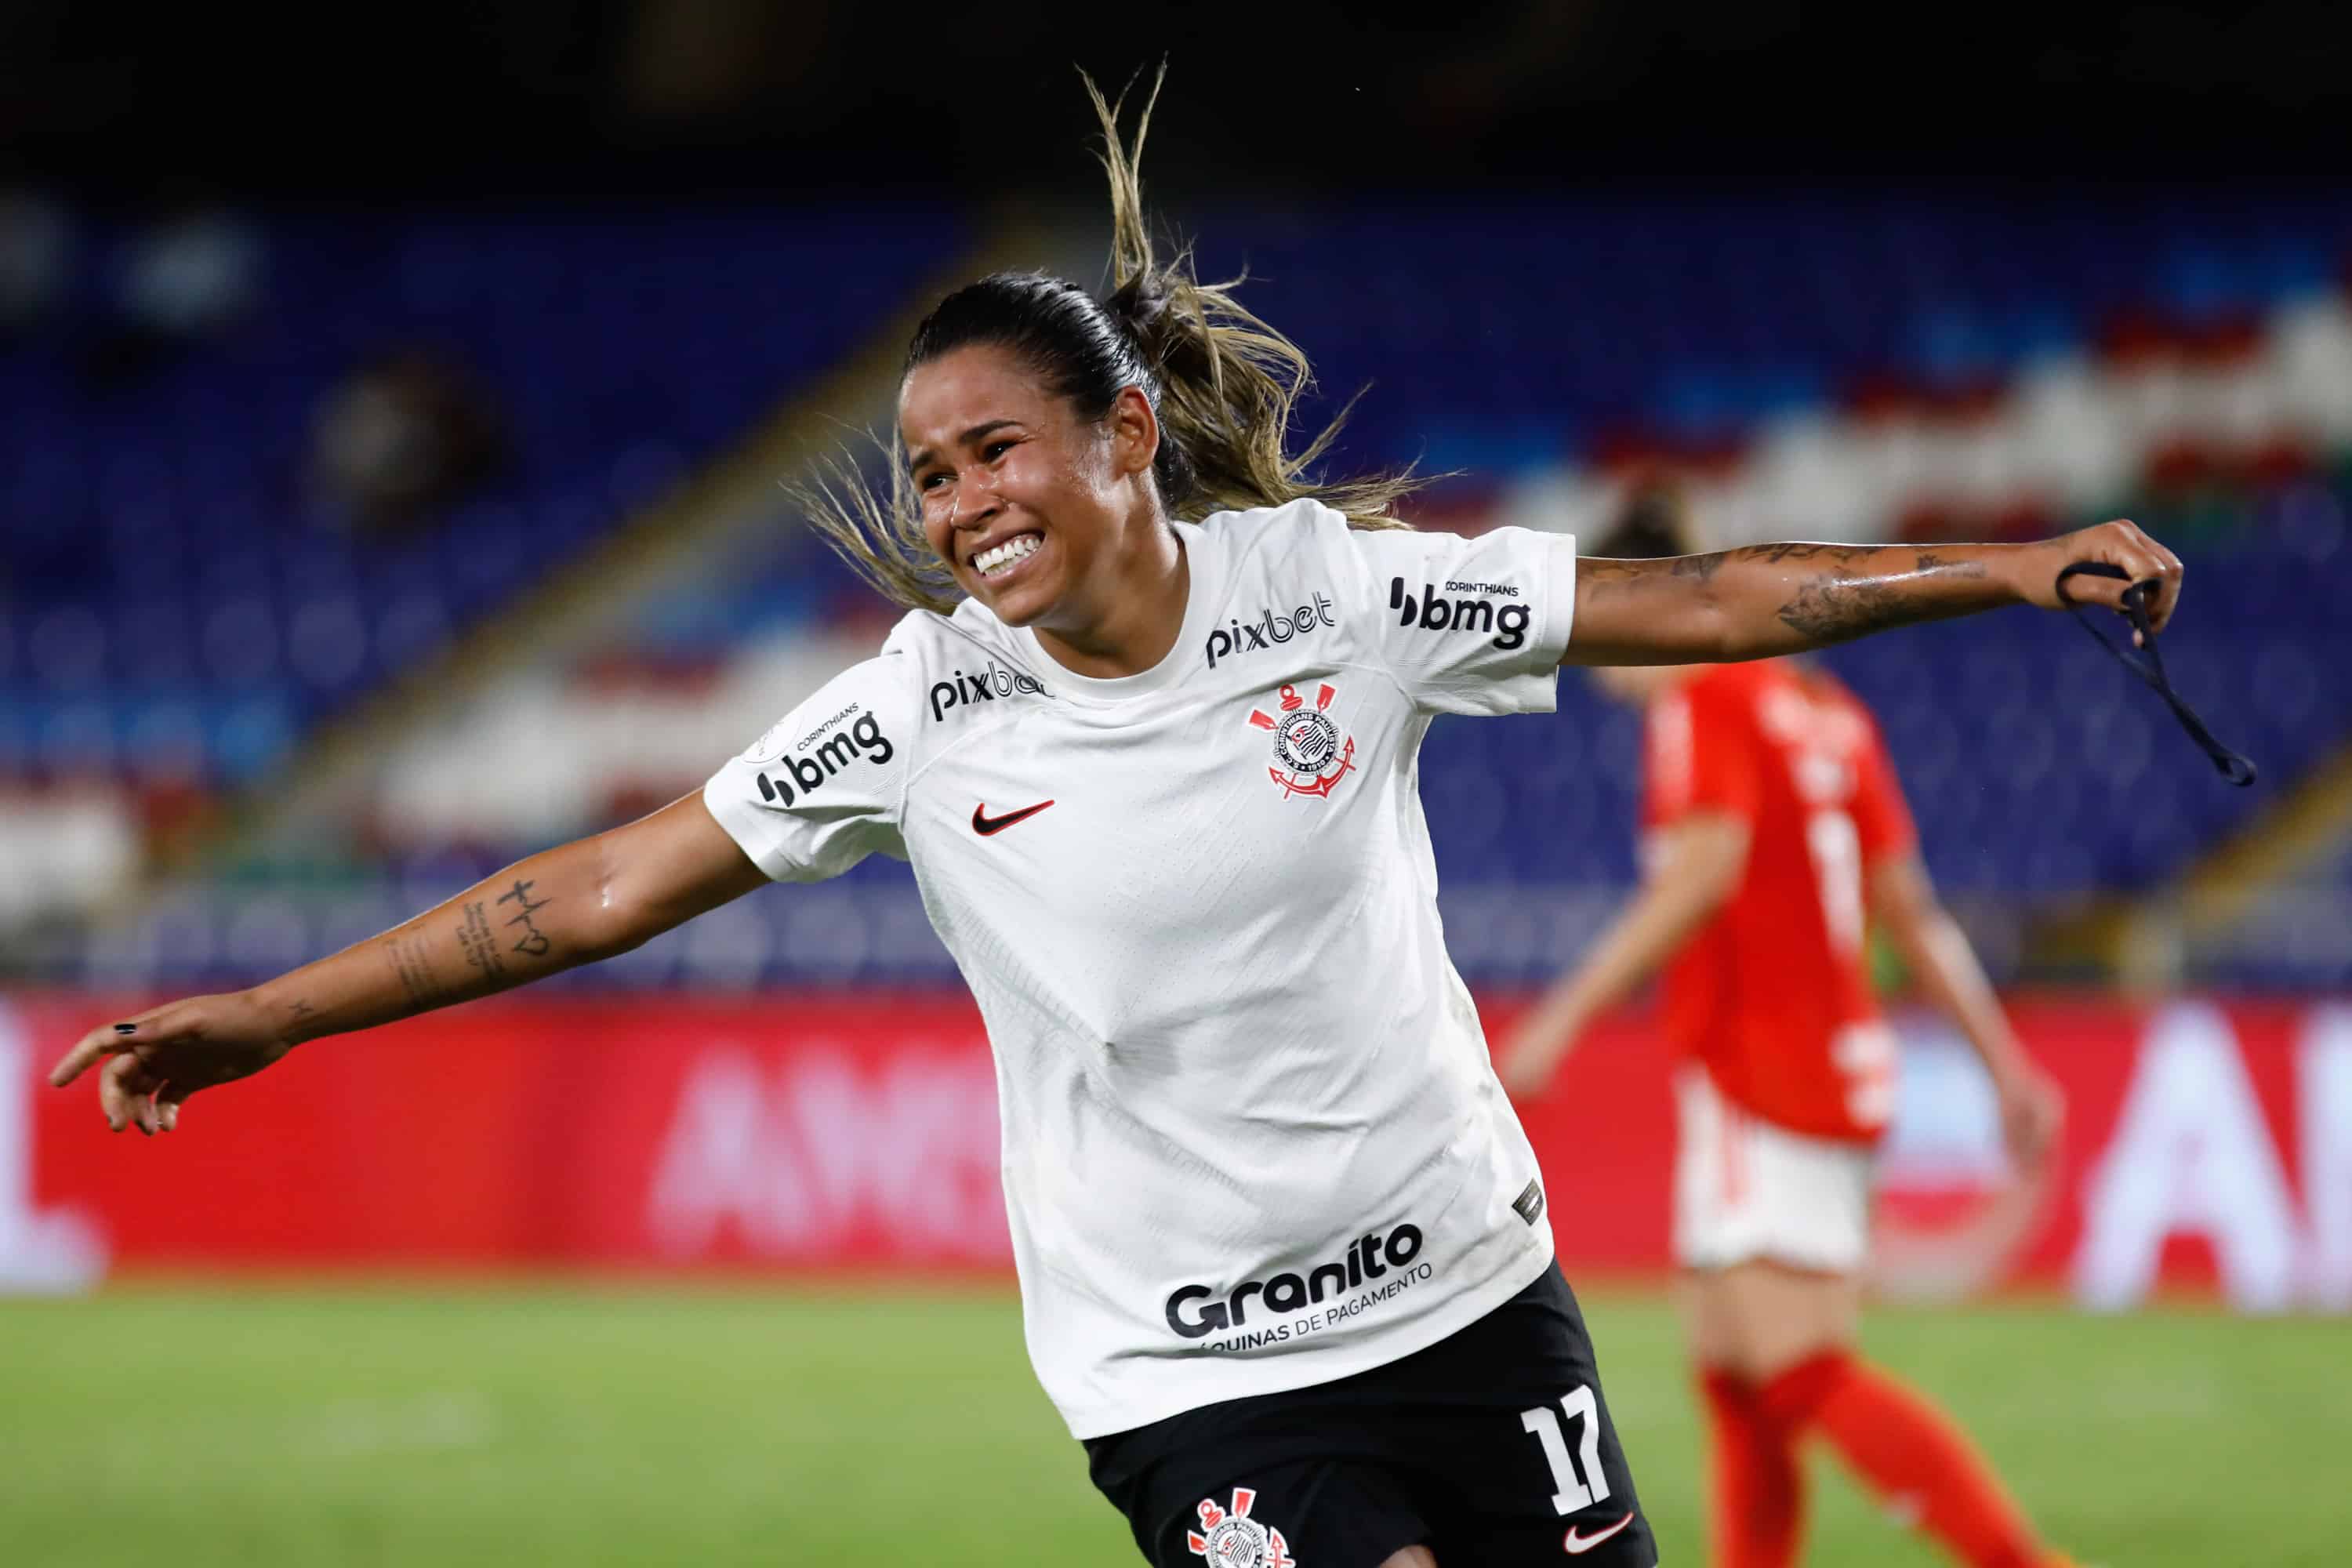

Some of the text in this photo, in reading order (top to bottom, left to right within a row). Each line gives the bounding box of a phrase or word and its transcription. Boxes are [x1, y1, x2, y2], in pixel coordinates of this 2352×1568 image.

[1419, 583, 1531, 650] bmg
[1445, 580, 1519, 597] CORINTHIANS
[1206, 591, 1336, 670] pixbet
[781, 710, 894, 795] bmg
[797, 702, 859, 751] CORINTHIANS
[1279, 713, 1314, 756] CORINTHIANS
[1314, 716, 1336, 753] PAULISTA
[1165, 1223, 1423, 1339] Granito
[1200, 1263, 1432, 1352] QUINAS DE PAGAMENTO
[1519, 1384, 1611, 1517] 17
